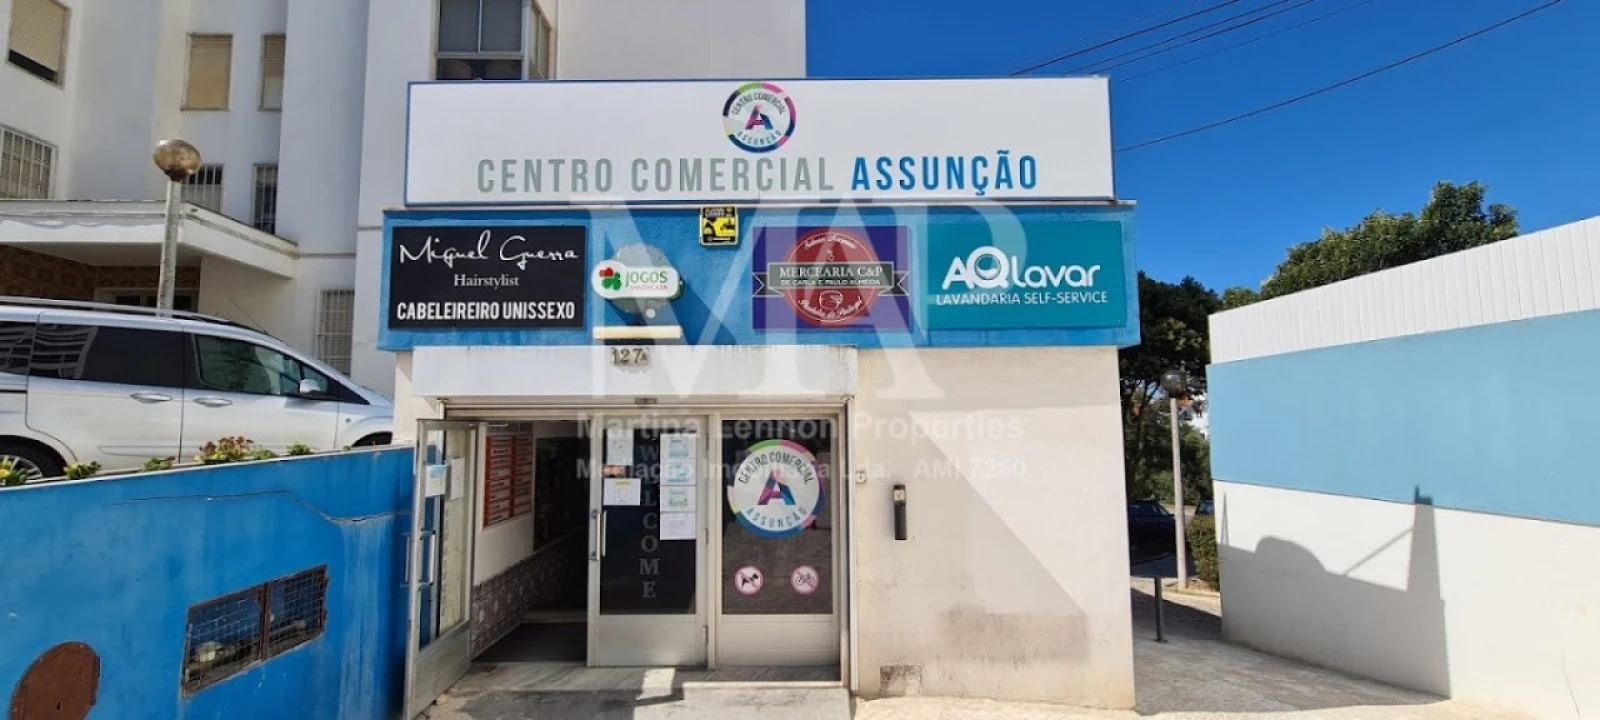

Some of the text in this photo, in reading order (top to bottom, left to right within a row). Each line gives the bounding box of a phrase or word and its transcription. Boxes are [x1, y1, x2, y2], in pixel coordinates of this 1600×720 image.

[477, 150, 1038, 195] CENTRO COMERCIAL ASSUNÇÃO
[399, 230, 579, 270] Miguel Guerra
[453, 273, 519, 288] Hairstylist
[625, 271, 668, 287] JOGOS
[779, 265, 883, 277] MERCEARIA C&P
[936, 290, 1108, 305] LAVANDARIA SELF-SERVICE
[396, 301, 575, 320] CABELEIREIRO UNISSEXO
[738, 455, 767, 484] CENTRO
[769, 451, 815, 485] COMERCIAL
[638, 444, 661, 599] WLCOME
